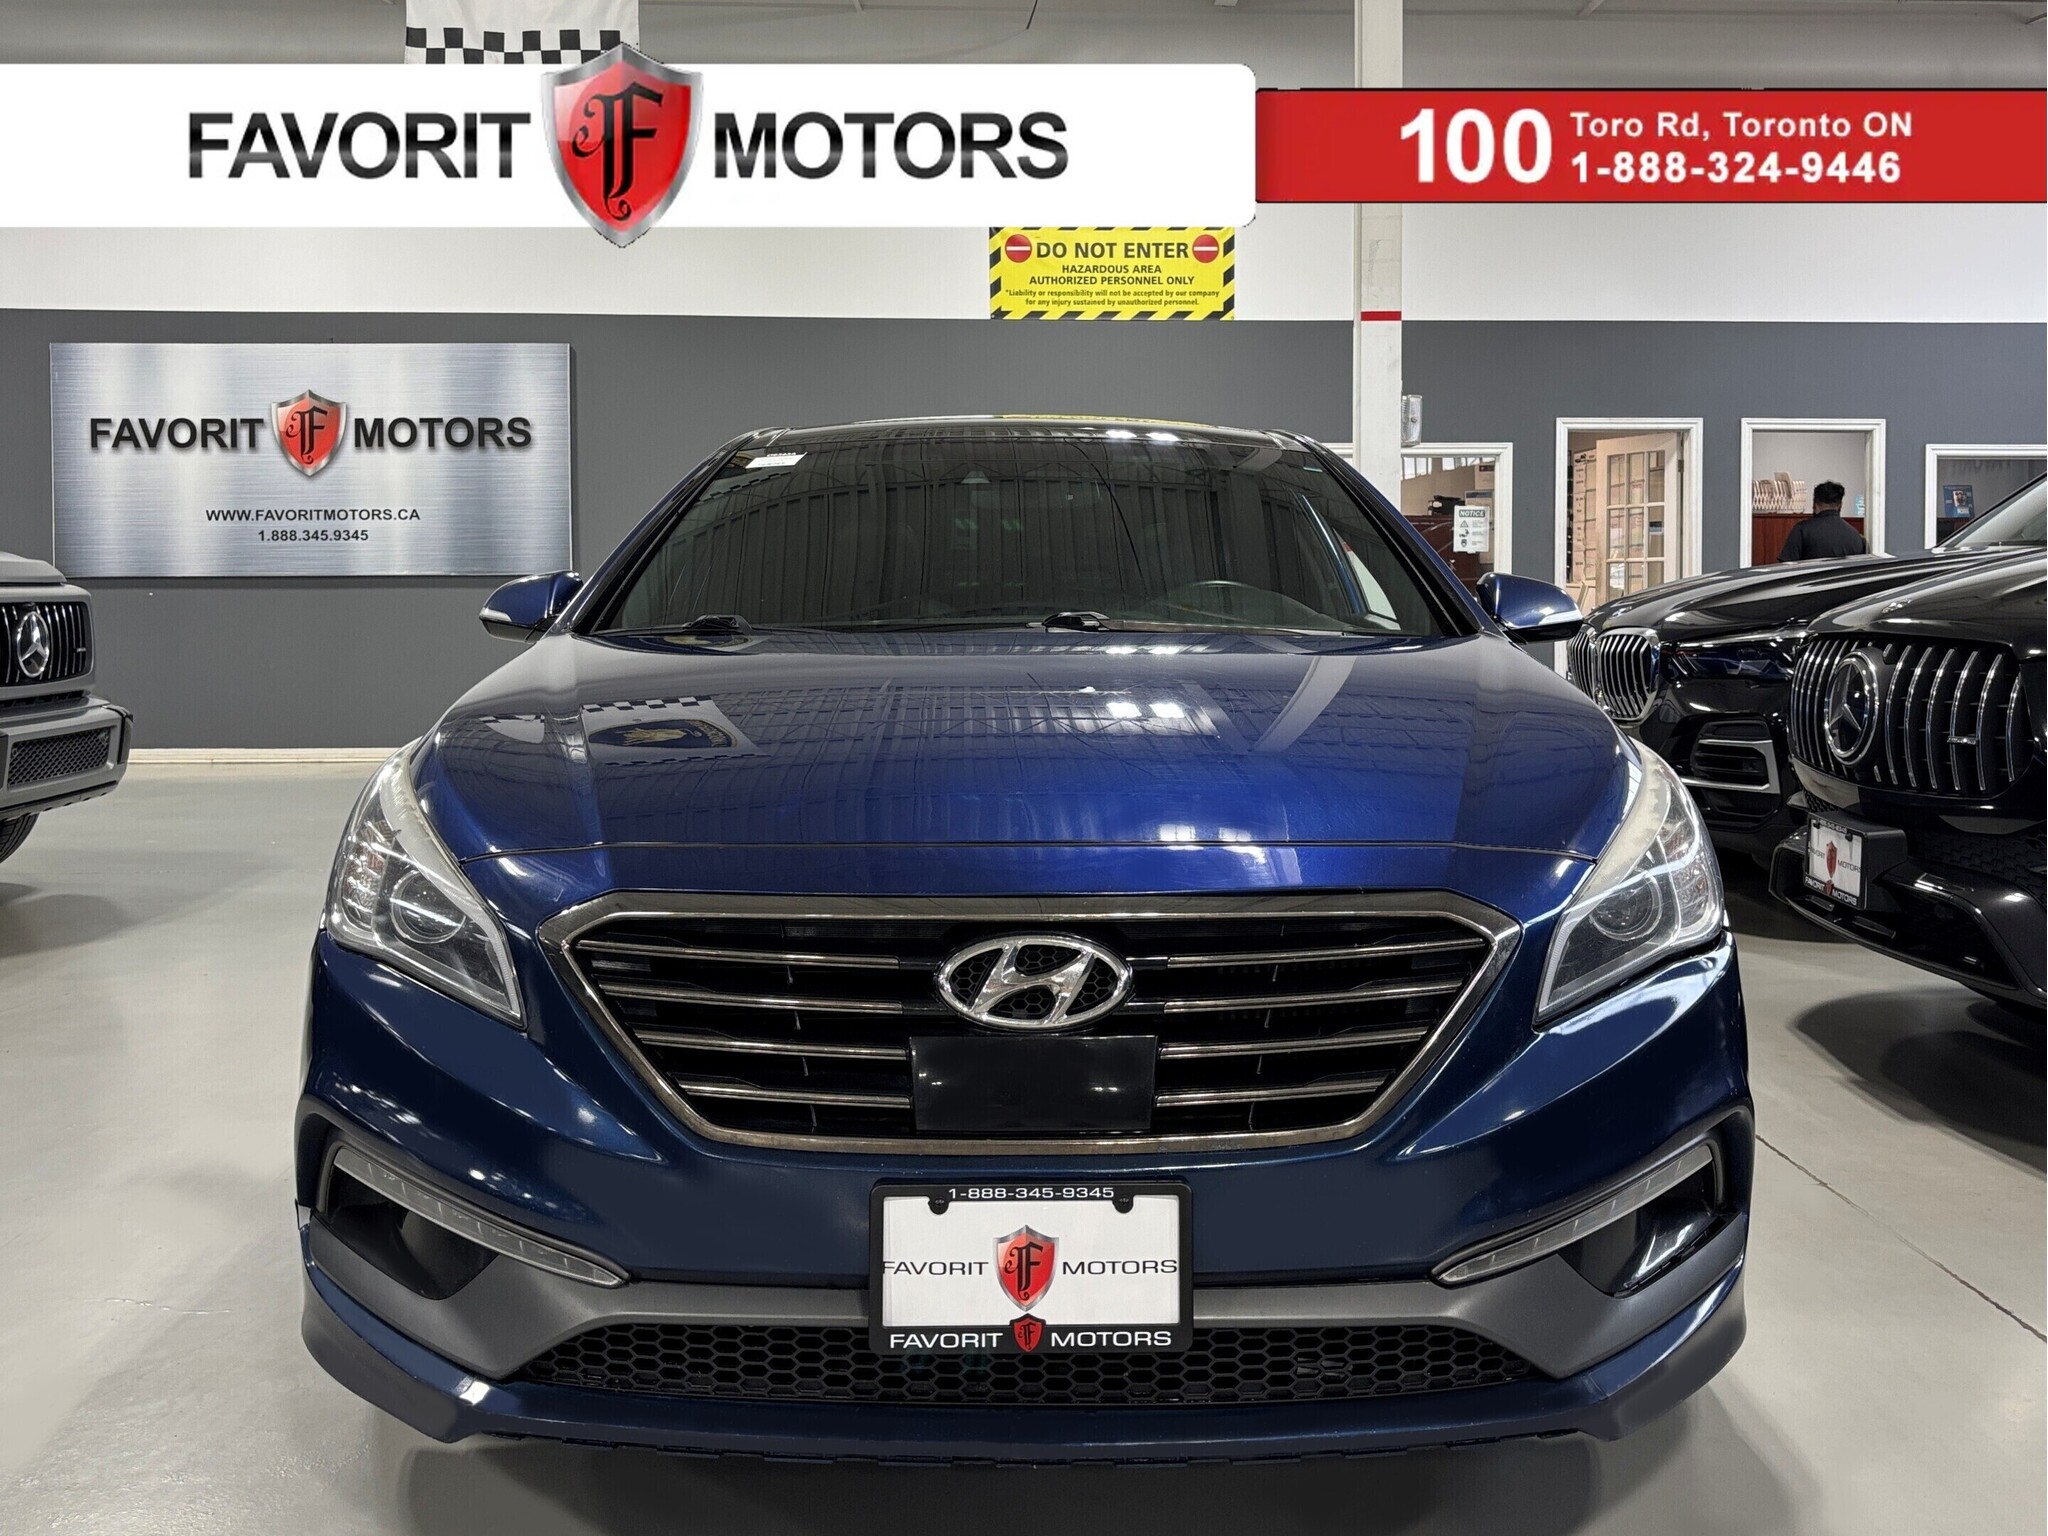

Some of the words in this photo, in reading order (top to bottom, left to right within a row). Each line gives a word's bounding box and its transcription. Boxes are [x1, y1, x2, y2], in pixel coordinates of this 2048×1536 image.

[1036, 242, 1067, 259] DO
[1075, 242, 1117, 259] NOT
[1124, 242, 1189, 259] ENTER
[1062, 265, 1129, 274] HAZARDOUS
[1133, 265, 1161, 274] AREA
[1029, 276, 1097, 285] AUTHORIZED
[1101, 276, 1163, 285] PERSONNEL
[1166, 276, 1195, 285] ONLY
[1047, 289, 1093, 298] responsibility
[1095, 289, 1107, 297] will
[1109, 289, 1120, 297] not
[1122, 289, 1131, 297] be
[1132, 289, 1162, 298] accepted
[1164, 289, 1173, 298] by
[1026, 298, 1036, 306] for
[1052, 298, 1071, 307] injury
[1073, 298, 1105, 306] sustained
[1107, 298, 1116, 307] by
[1118, 298, 1162, 306] unauthorized
[1164, 298, 1199, 307] personnel.
[89, 417, 264, 450] FAVORIT
[354, 417, 533, 449] MOTORS
[206, 508, 421, 523] WWW.FAVORITMOTORS.CA
[258, 528, 369, 543] 1.888.345.9345
[1805, 877, 1825, 891] FAVORIT
[1832, 889, 1857, 905] MOTORS
[948, 1187, 1115, 1200] 1-888-345-9345
[883, 1261, 989, 1275] FAVORIT
[1062, 1260, 1177, 1275] MOTORS
[889, 1332, 1004, 1349] FAVORIT
[1050, 1330, 1171, 1348] MOTORS
